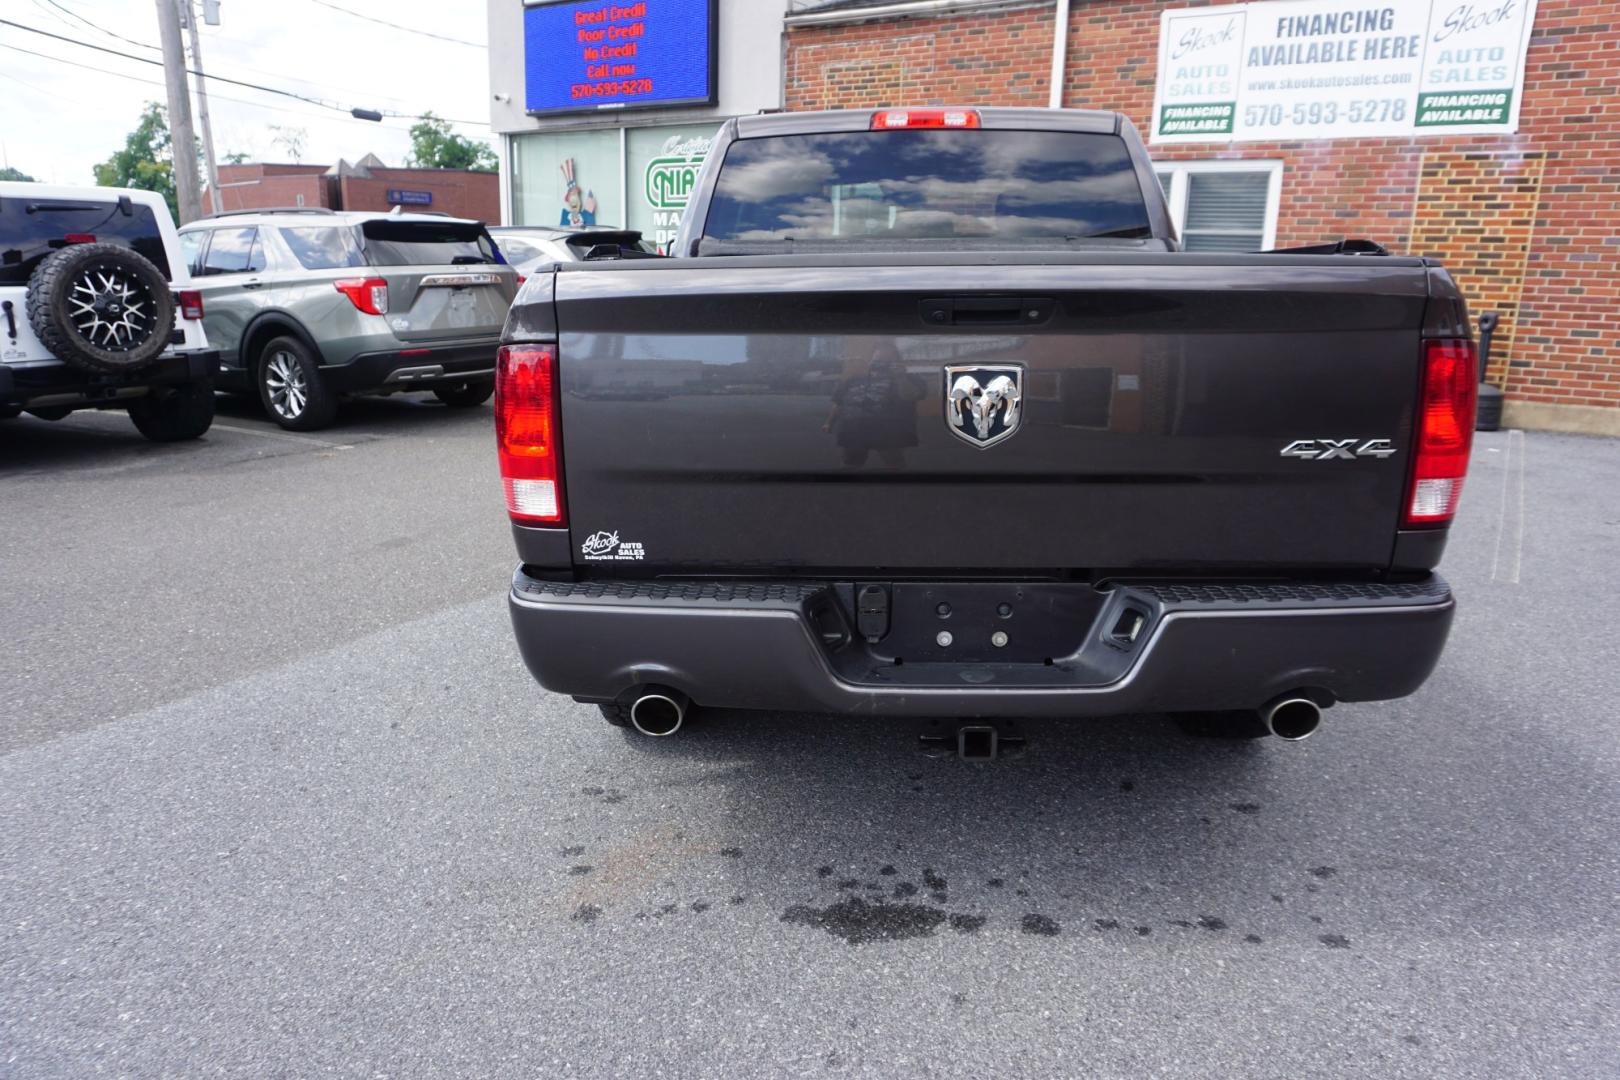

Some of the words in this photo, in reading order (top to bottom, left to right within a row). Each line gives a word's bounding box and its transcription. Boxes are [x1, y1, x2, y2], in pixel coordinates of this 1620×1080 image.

[576, 8, 607, 25] Great
[610, 2, 646, 21] Credit
[1276, 8, 1395, 38] FINANCING
[1433, 0, 1516, 42] Skook
[578, 29, 606, 42] Poor
[608, 22, 644, 40] Credit
[1172, 17, 1236, 60] Skook
[584, 46, 598, 61] No
[601, 42, 637, 59] Credit
[1247, 40, 1358, 67] AVAILABLE
[1363, 34, 1420, 61] HERE
[1437, 46, 1505, 65] AUTO
[587, 63, 609, 79] Call
[612, 64, 635, 77] now
[1175, 63, 1230, 80] AUTO
[1428, 65, 1508, 84] SALES
[572, 79, 652, 98] 570-593-5278
[1168, 80, 1231, 97] SALES
[1247, 72, 1412, 91] www.skookautosales.com
[1422, 93, 1507, 108] FINANCING
[1163, 105, 1232, 119] FINANCING
[1244, 98, 1407, 127] 570-593-5278
[1420, 108, 1504, 122] AVAILABLE
[1162, 119, 1229, 133] AVAILABLE
[653, 212, 682, 226] MA
[581, 530, 619, 554] Skook
